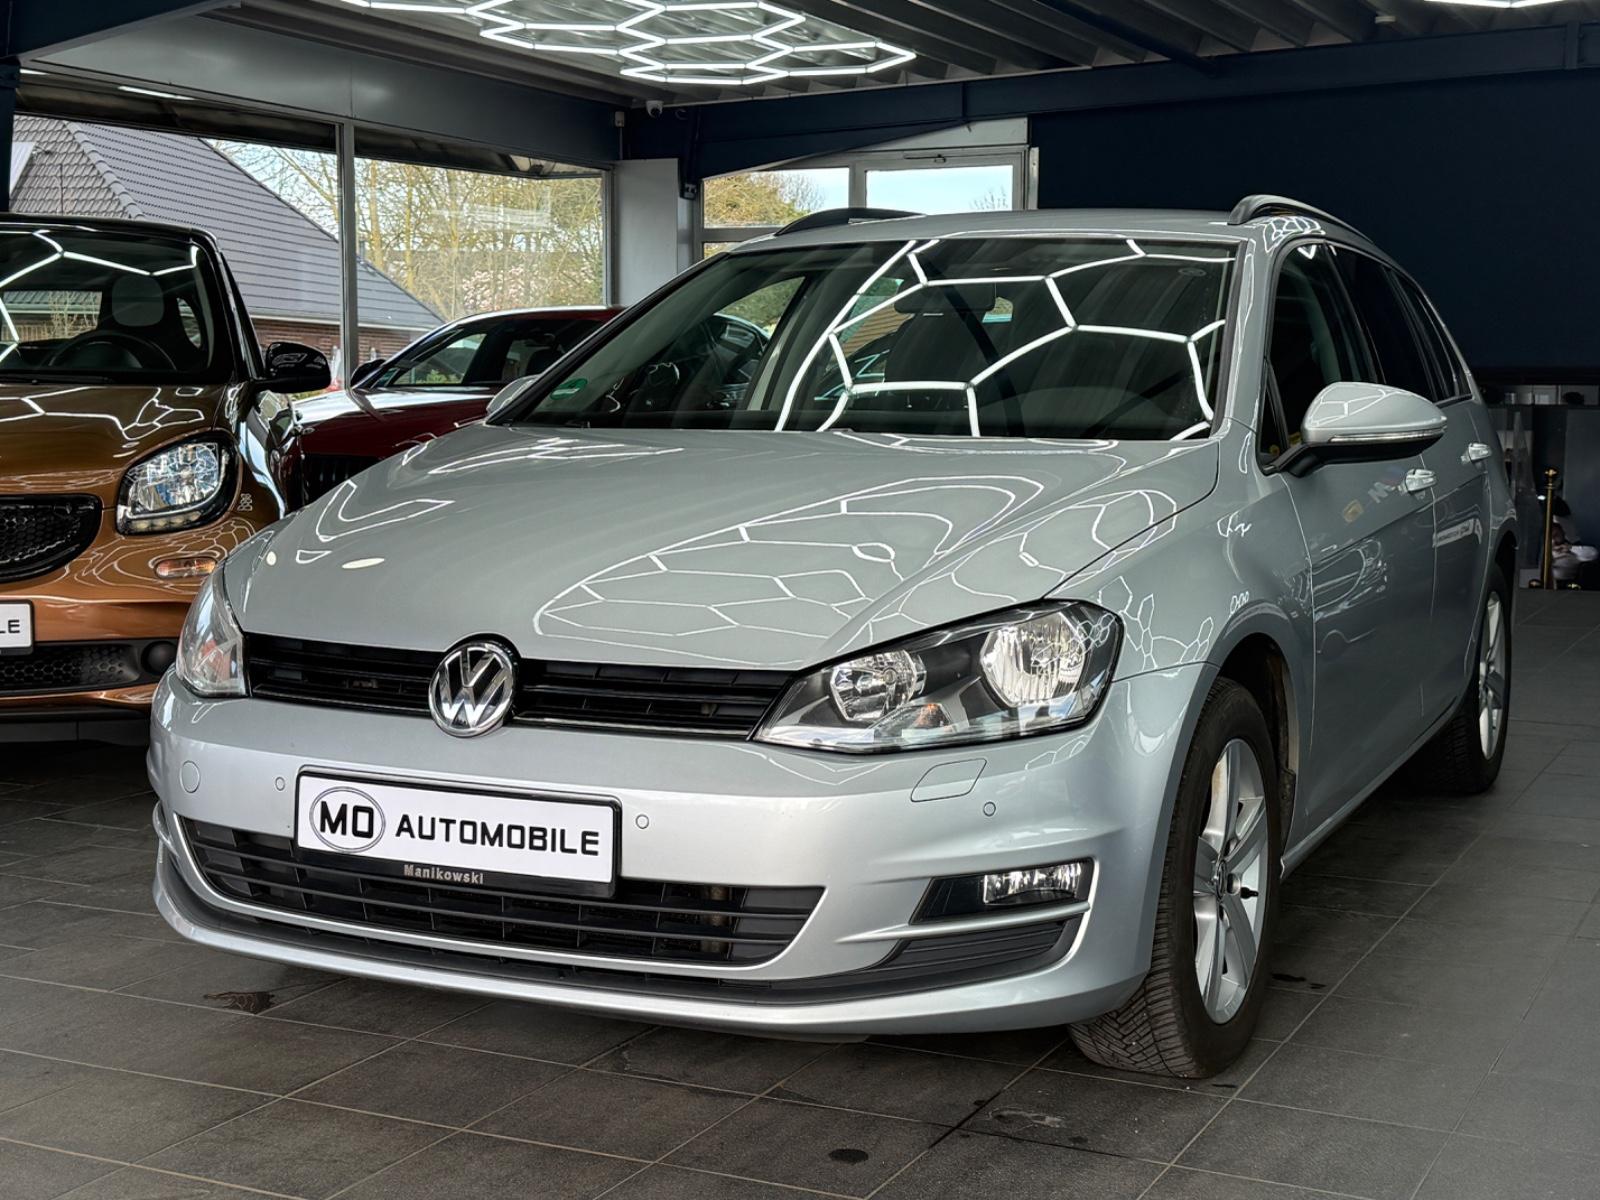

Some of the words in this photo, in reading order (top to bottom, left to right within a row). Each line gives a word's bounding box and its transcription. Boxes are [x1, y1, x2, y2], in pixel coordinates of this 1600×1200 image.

[0, 619, 20, 634] E
[433, 645, 510, 733] VW
[319, 800, 374, 839] MO
[395, 814, 600, 857] AUTOMOBILE
[403, 864, 484, 885] Manikowski
